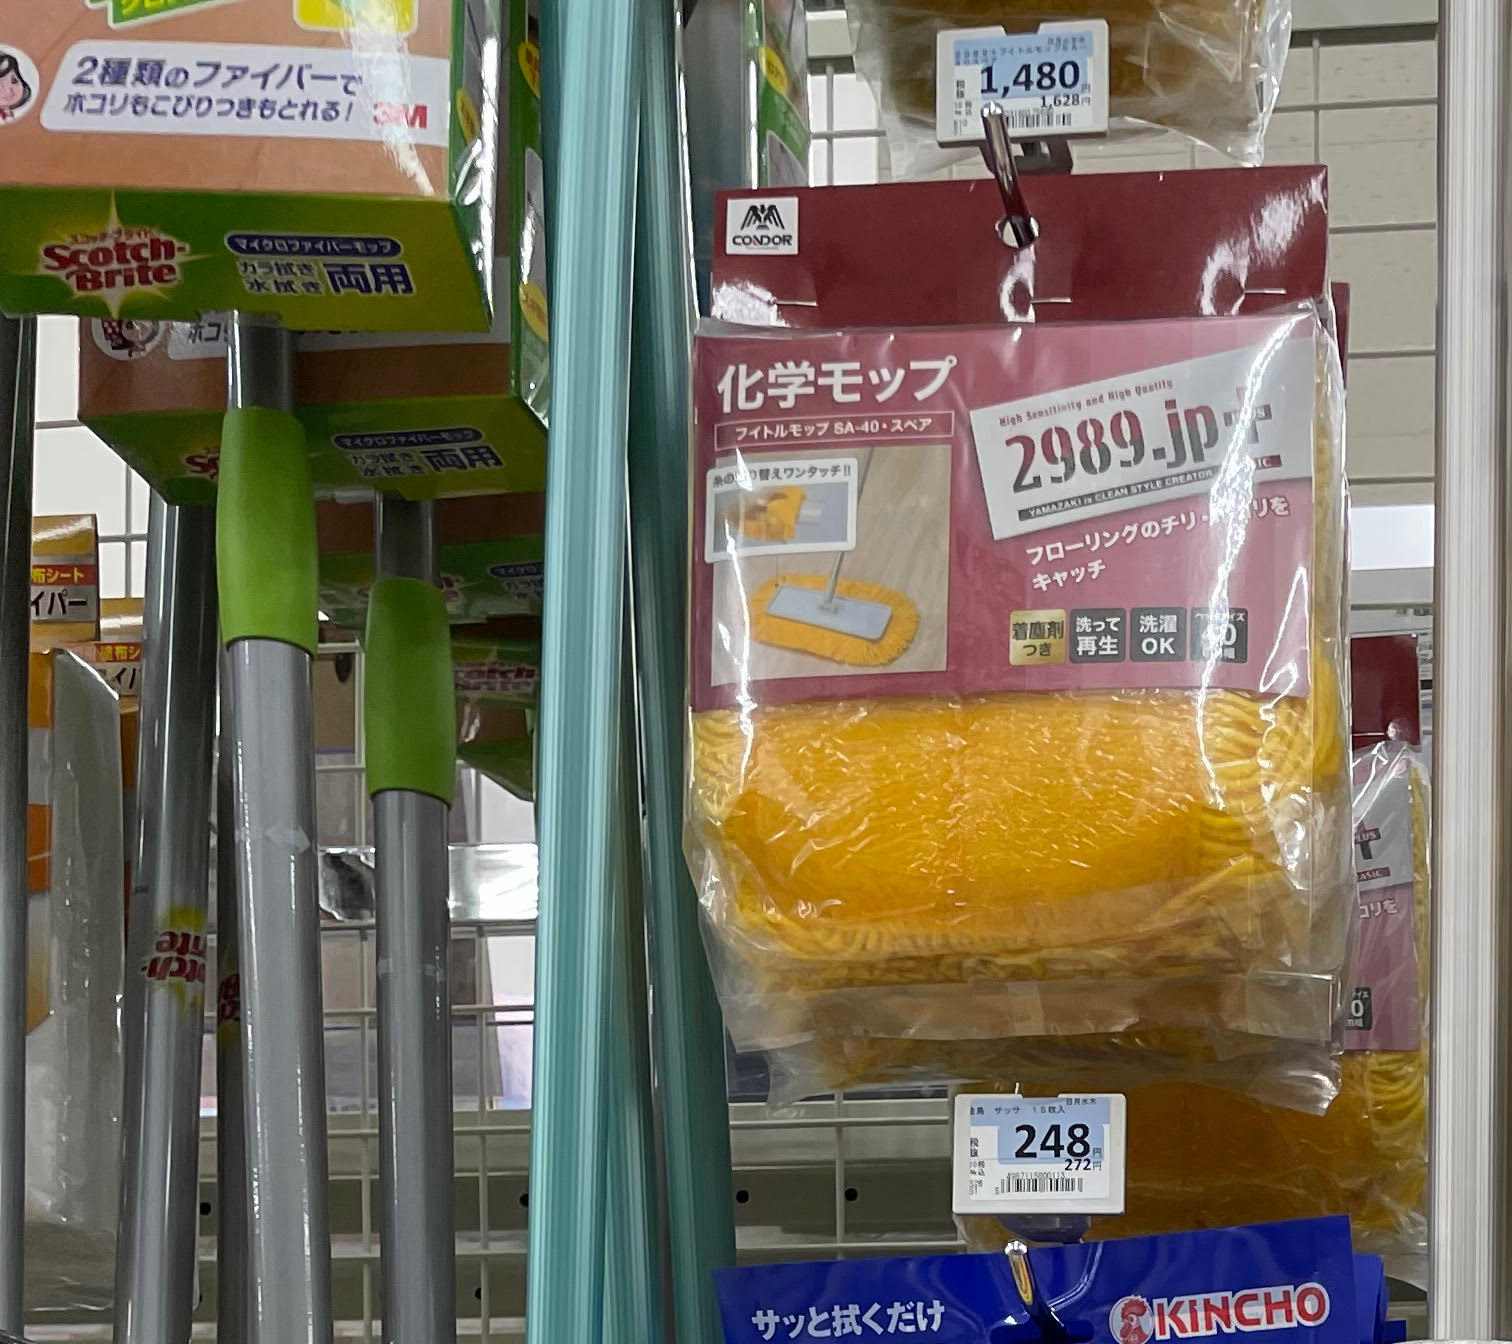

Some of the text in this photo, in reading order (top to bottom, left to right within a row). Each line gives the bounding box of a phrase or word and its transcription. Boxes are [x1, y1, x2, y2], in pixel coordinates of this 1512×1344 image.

[71, 56, 363, 96] 2種類のファイバーで
[731, 235, 793, 249] CONDOR
[75, 262, 178, 292] Brite
[327, 263, 414, 296] 両用
[717, 355, 958, 413] 化学モップ
[1032, 559, 1107, 593] キャッチ
[1076, 615, 1121, 633] 洗って
[1139, 614, 1179, 634] 洗濯
[1077, 635, 1120, 657] 再生
[1141, 636, 1176, 656] OK
[751, 1299, 945, 1340] サッと拭くだけ
[1154, 1283, 1329, 1338] KINCHO
